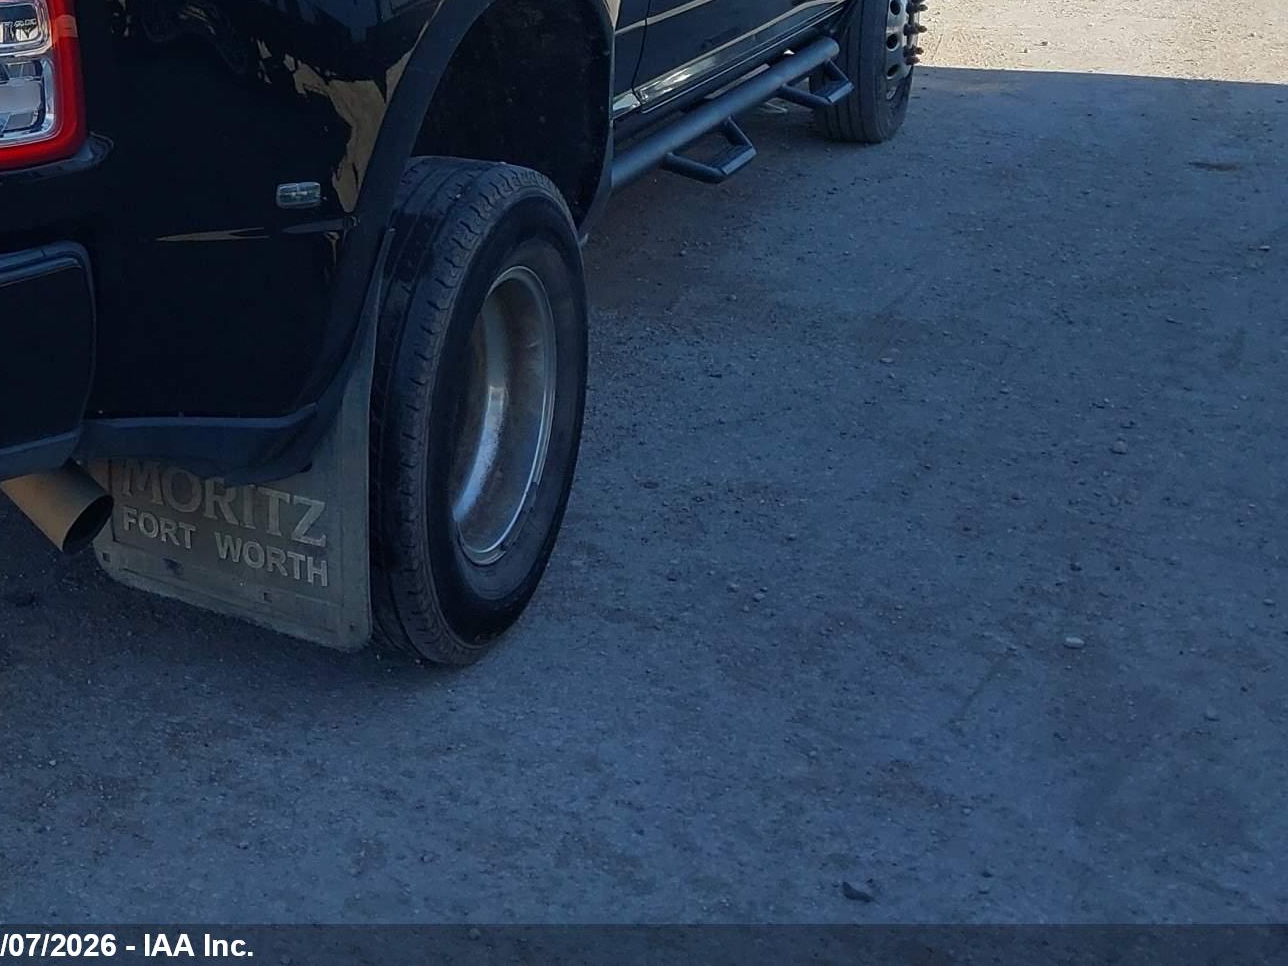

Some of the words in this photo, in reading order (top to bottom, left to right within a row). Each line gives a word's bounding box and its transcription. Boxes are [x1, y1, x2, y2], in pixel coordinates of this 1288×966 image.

[120, 459, 327, 548] MORITZ
[122, 505, 197, 550] FORT
[214, 532, 328, 587] WORTH
